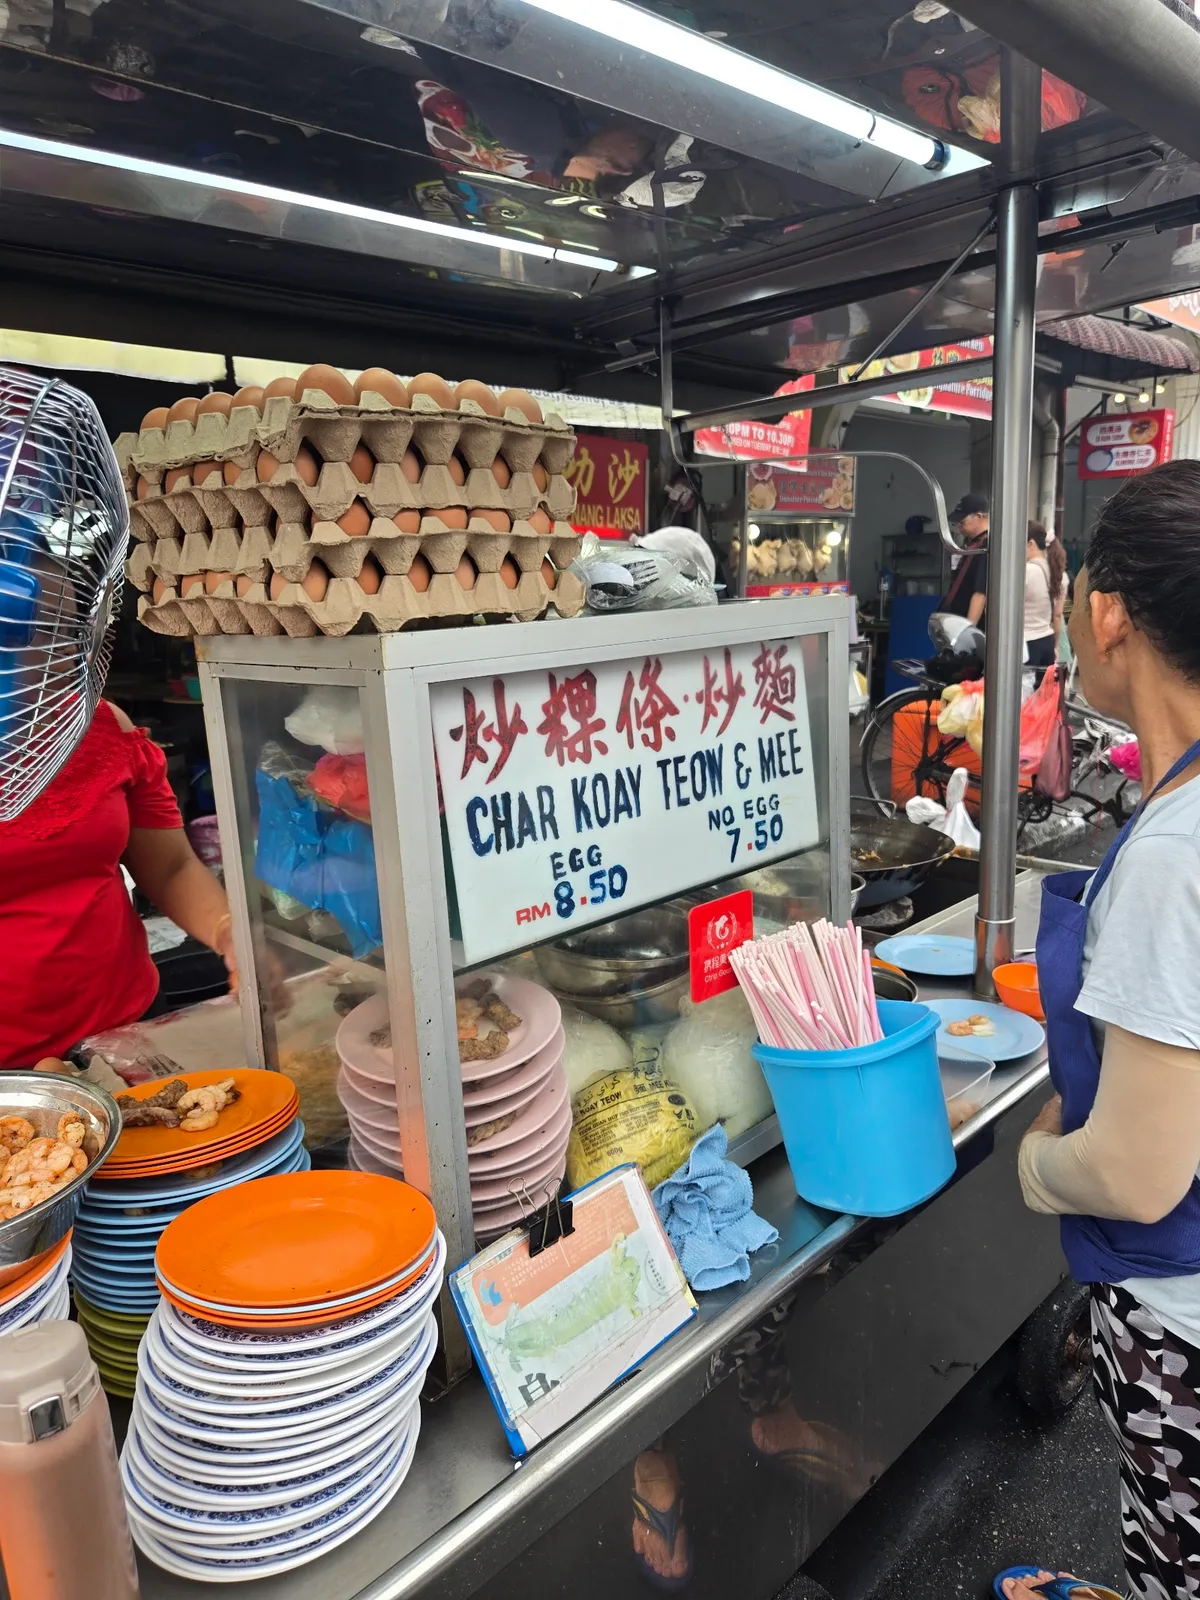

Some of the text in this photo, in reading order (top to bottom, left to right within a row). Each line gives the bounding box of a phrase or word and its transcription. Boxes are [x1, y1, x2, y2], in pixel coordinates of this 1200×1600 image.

[606, 506, 641, 531] LAKSA
[465, 727, 804, 857] CHAR KOAY TEOW & MEE
[708, 794, 780, 831] NO EGG
[726, 815, 784, 863] 7.50
[550, 844, 602, 880] EGG
[703, 951, 732, 973] 携程美
[579, 1101, 599, 1116] KOAY
[600, 1091, 623, 1106] TEOW
[607, 1145, 624, 1157] 600g
